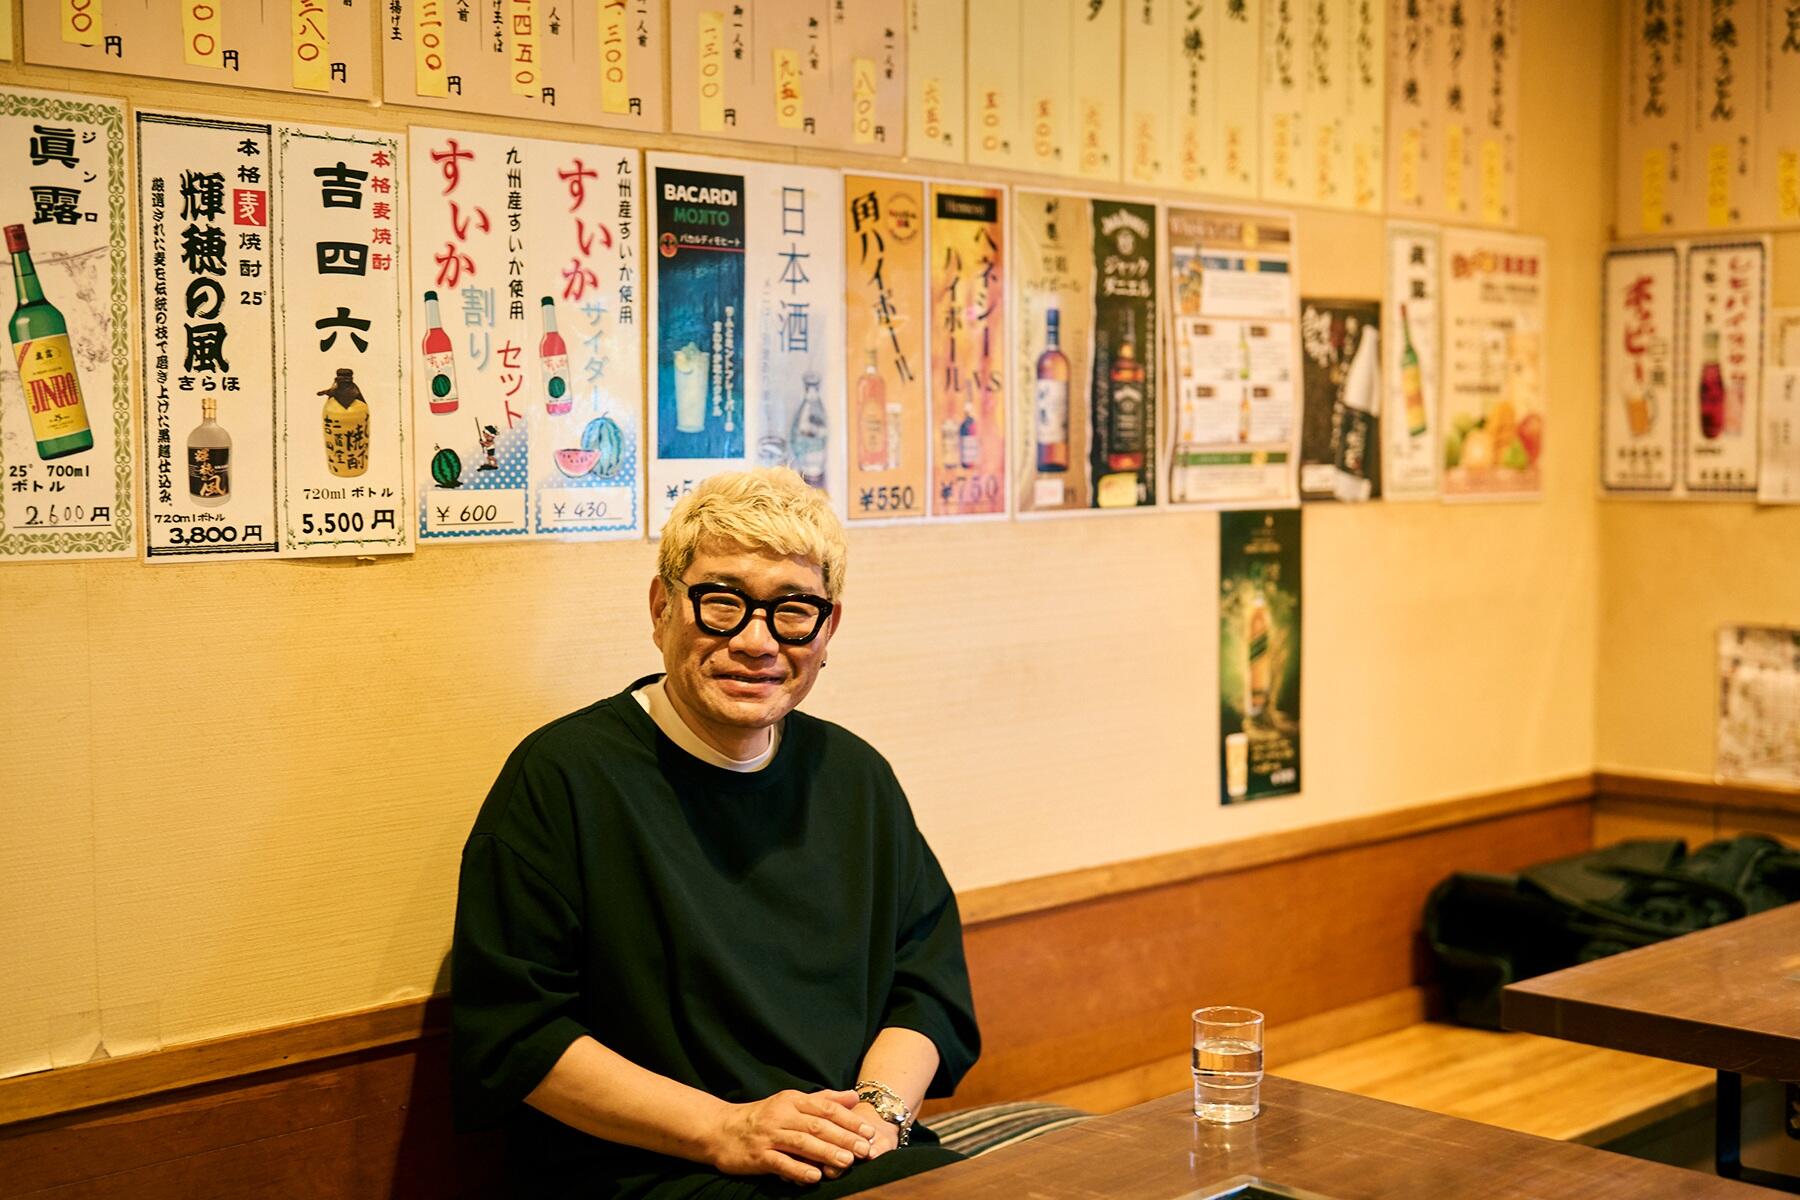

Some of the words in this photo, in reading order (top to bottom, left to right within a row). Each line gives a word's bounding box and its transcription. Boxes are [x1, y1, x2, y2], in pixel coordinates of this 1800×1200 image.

[236, 137, 267, 278] 本格麦焼酎
[313, 160, 372, 354] 吉四六
[370, 150, 392, 272] 本格麦焼酎
[506, 146, 525, 321] 九州産すいか使用
[557, 159, 613, 303] すいか
[616, 157, 633, 325] 九州産すいか使用
[664, 183, 738, 206] BACARDI
[674, 206, 731, 227] MOJITO
[430, 138, 491, 289] すいか
[497, 339, 523, 430] セット
[777, 186, 811, 353] 日本酒
[27, 371, 80, 414] JINRO
[12, 480, 66, 494] ボトル
[351, 486, 395, 499] ボトル
